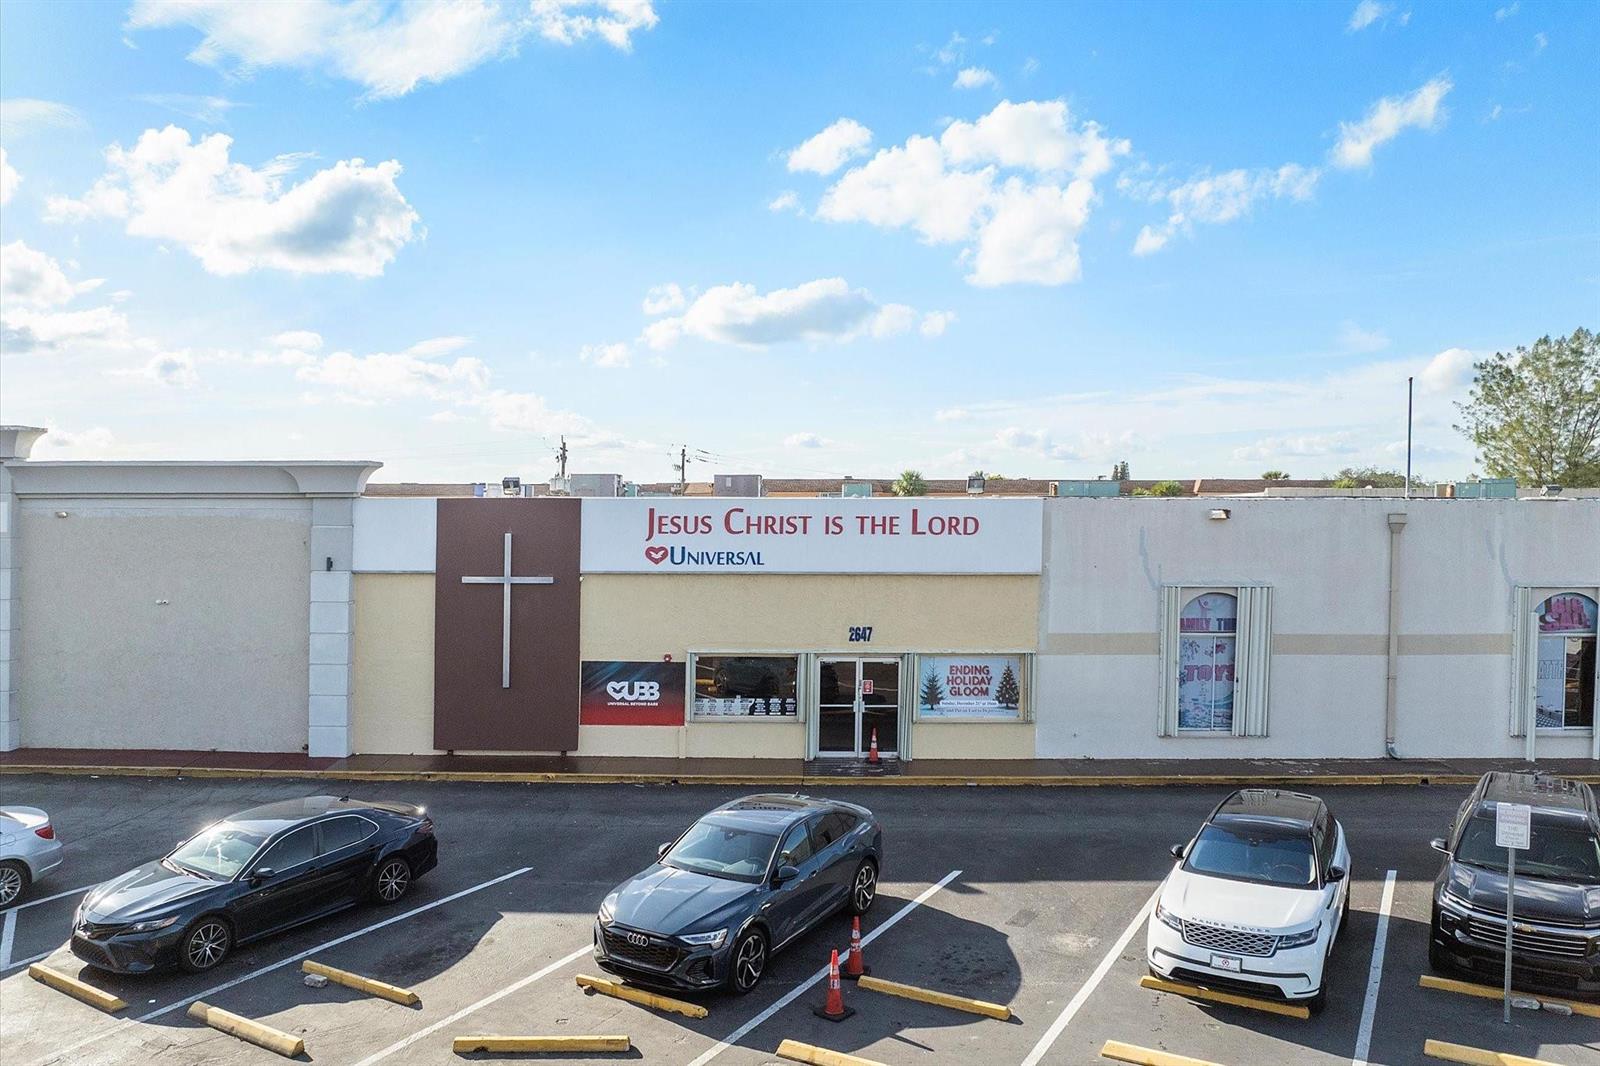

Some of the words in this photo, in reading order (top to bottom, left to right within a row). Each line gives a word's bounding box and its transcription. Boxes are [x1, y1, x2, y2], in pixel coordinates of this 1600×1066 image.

[645, 507, 713, 542] JESUS
[724, 507, 812, 536] CHRIST
[824, 515, 844, 536] IS
[856, 515, 900, 536] THE
[911, 508, 980, 536] LORD
[669, 545, 765, 566] UNIVERSAL
[848, 626, 873, 642] 2647
[949, 665, 990, 675] ENDING
[946, 676, 993, 686] HOLIDAY
[949, 686, 990, 697] GLOOM
